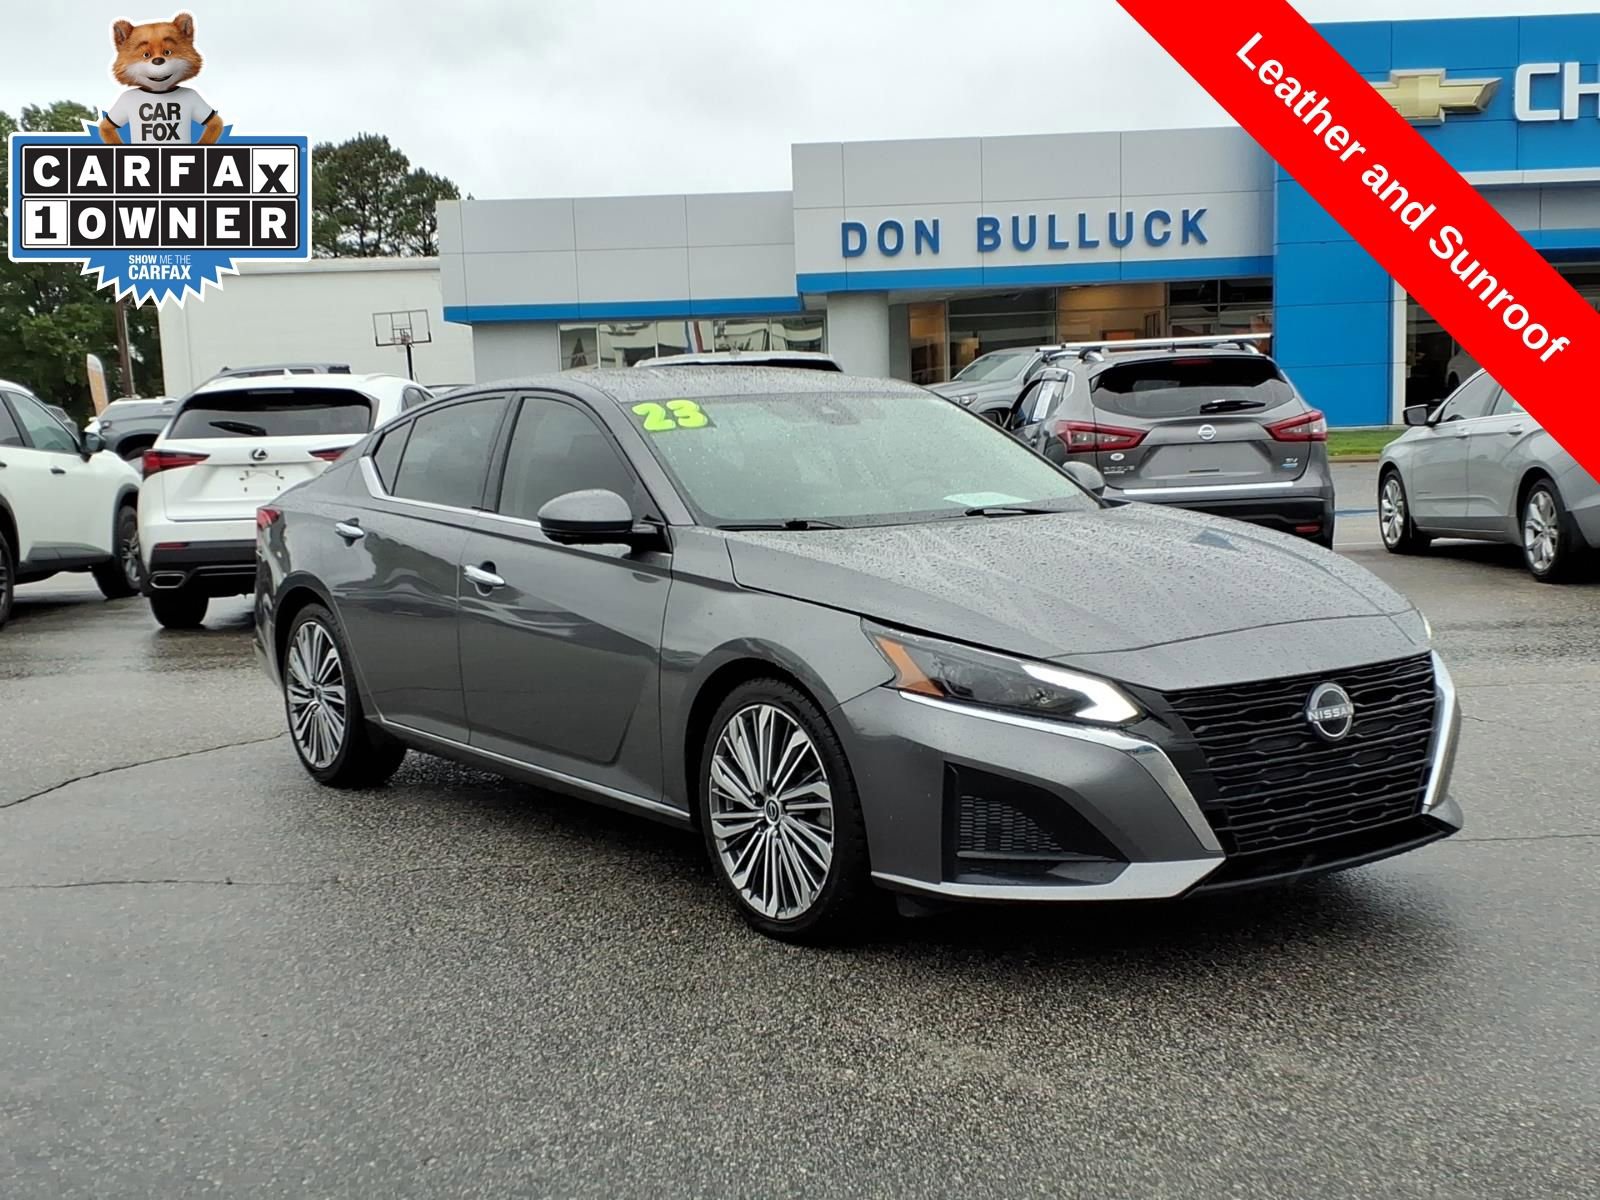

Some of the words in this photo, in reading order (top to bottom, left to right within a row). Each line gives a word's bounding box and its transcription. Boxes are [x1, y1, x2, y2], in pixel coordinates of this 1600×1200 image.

[841, 218, 940, 257] DON
[976, 208, 1208, 252] BULLUCK
[632, 399, 709, 431] 23
